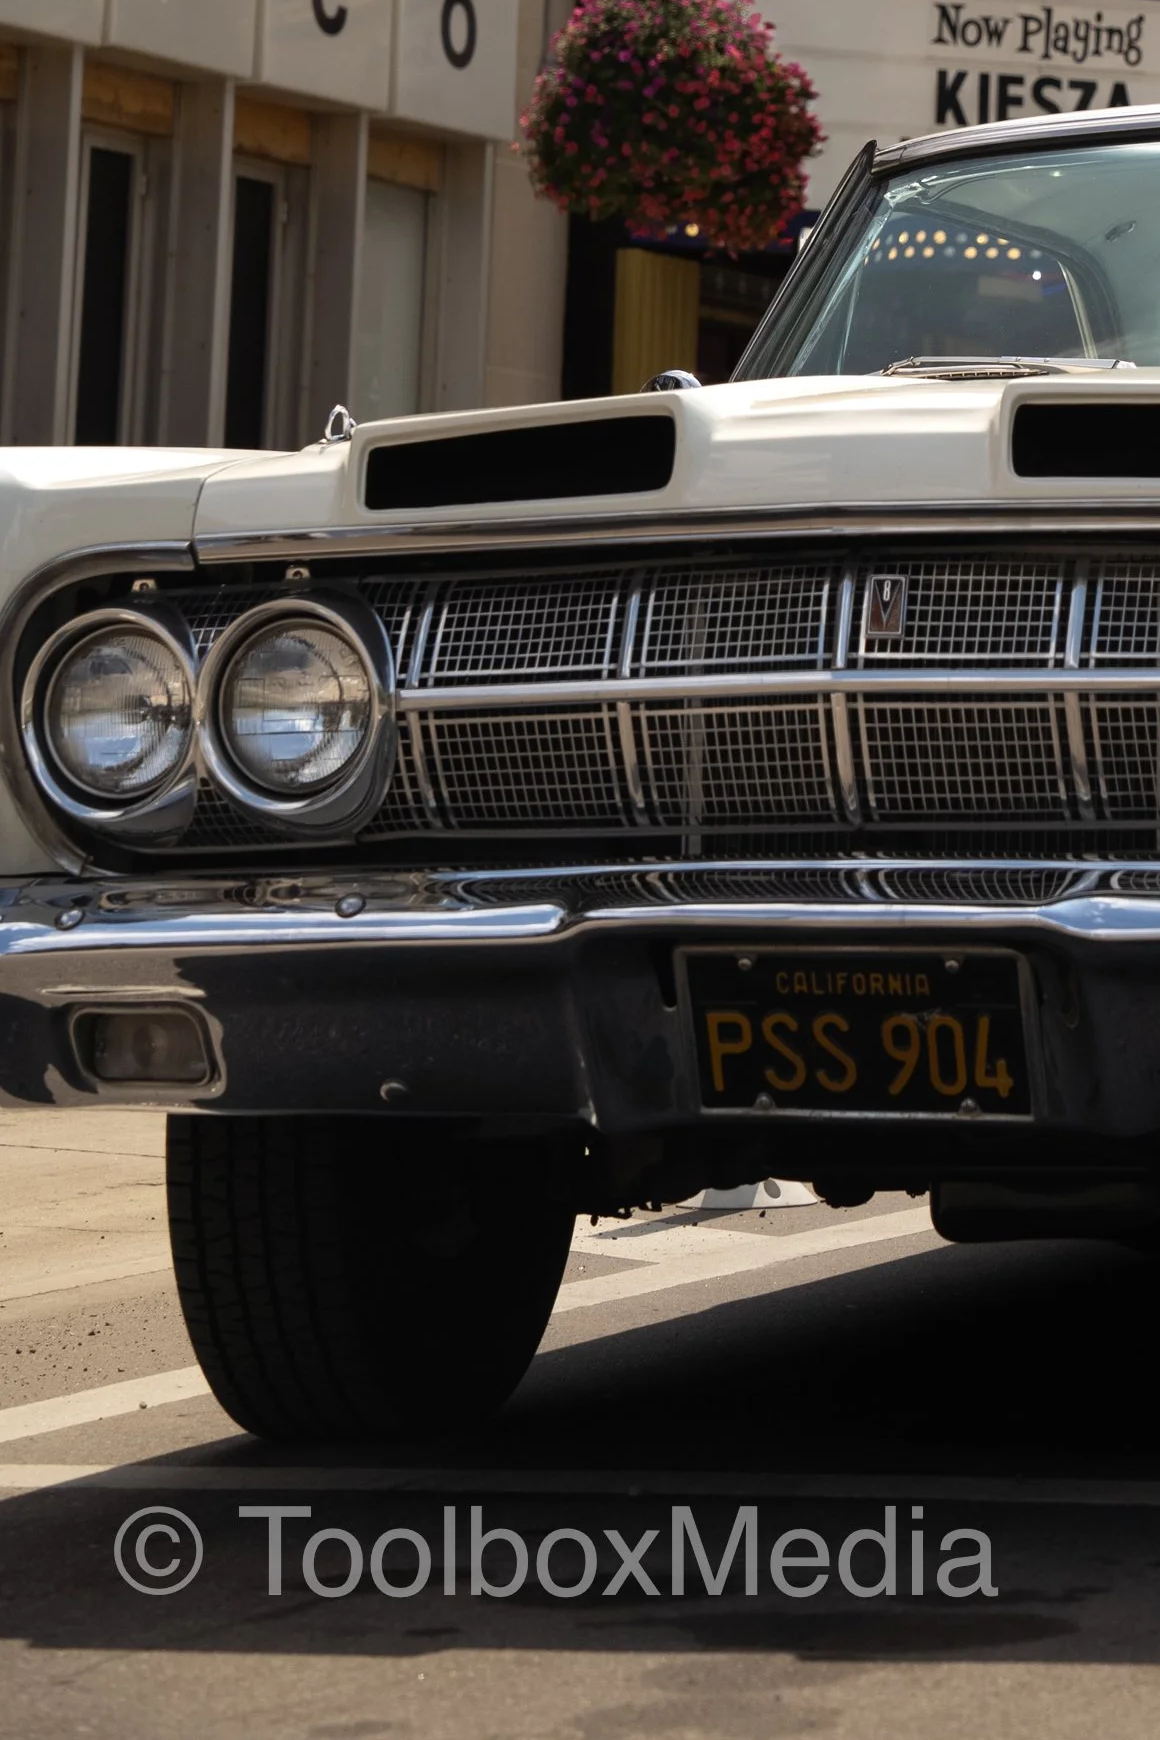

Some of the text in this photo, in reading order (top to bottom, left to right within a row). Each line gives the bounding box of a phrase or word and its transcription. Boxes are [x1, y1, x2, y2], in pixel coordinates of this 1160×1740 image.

[932, 3, 1146, 66] Now Playing
[775, 971, 931, 997] CALIFORNIA
[705, 1011, 1015, 1098] PSS 904
